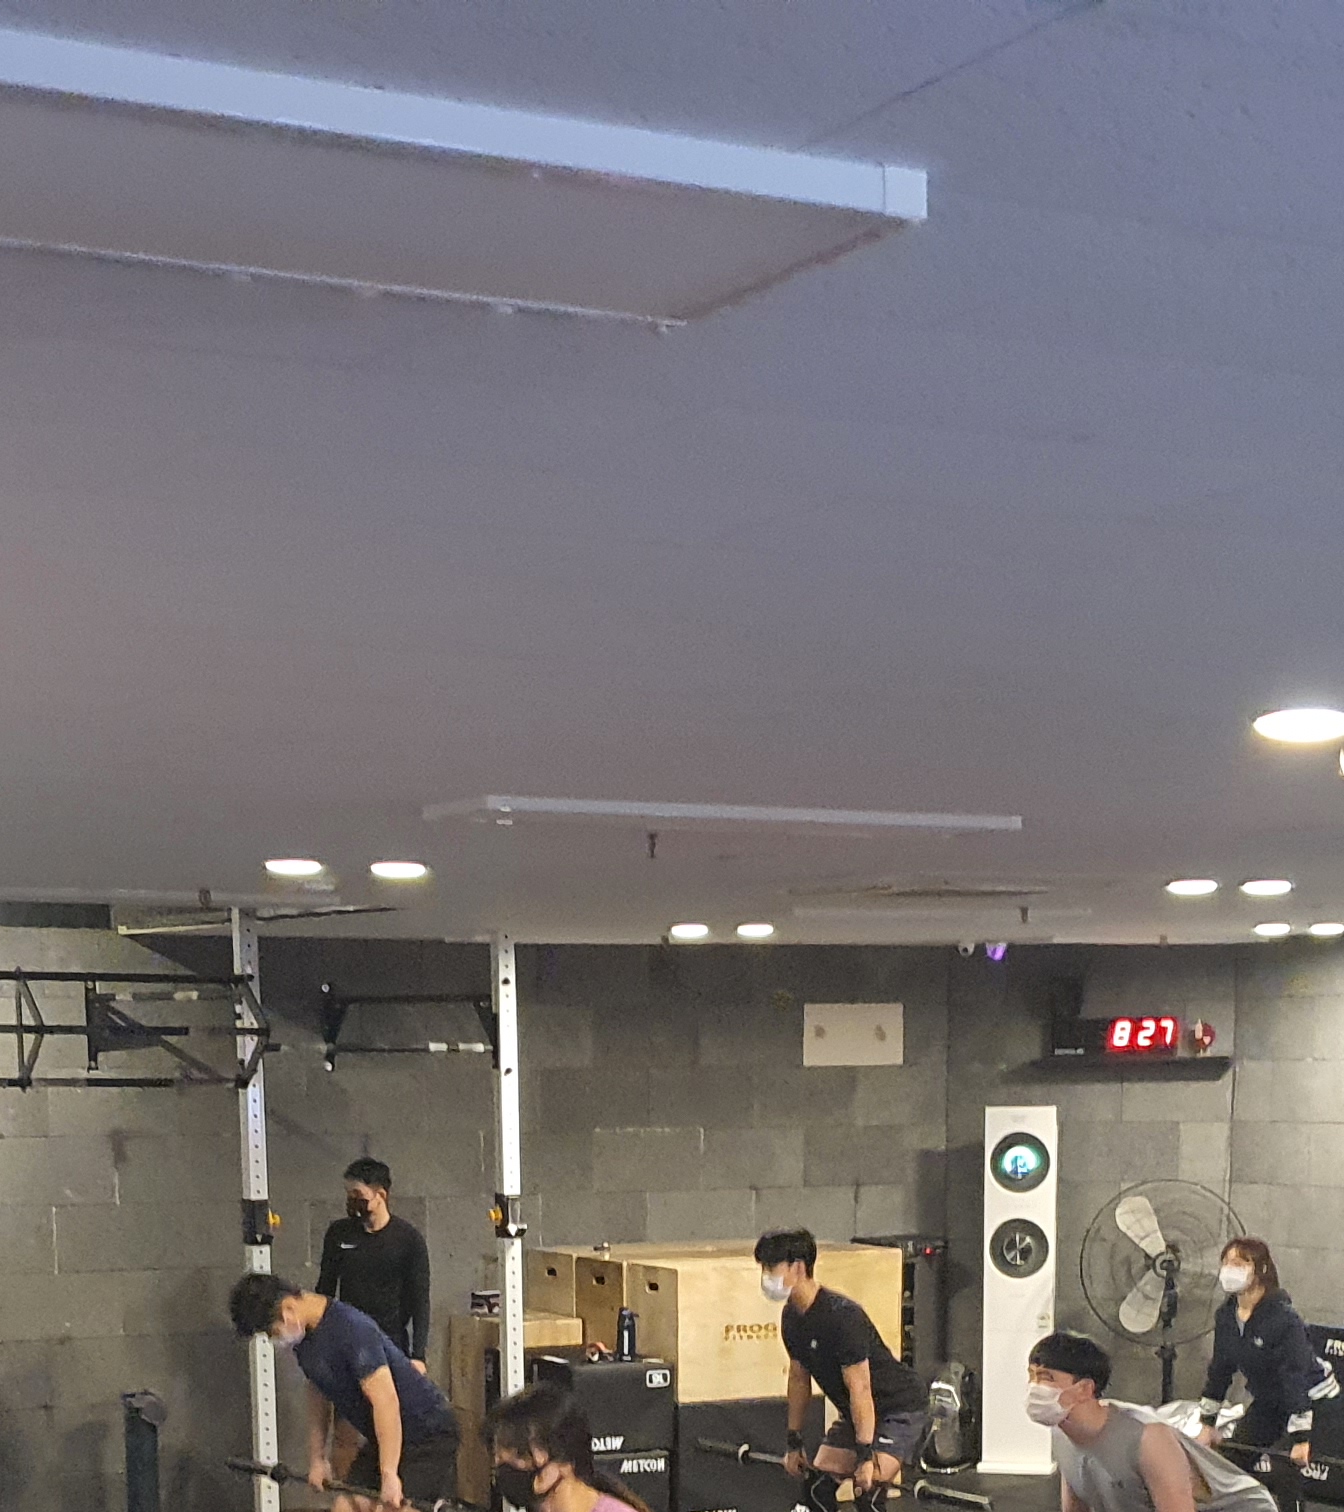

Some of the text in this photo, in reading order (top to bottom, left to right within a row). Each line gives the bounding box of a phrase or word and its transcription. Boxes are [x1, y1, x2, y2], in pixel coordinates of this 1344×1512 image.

[725, 1323, 777, 1334] FROG
[591, 1436, 624, 1451] METC
[620, 1458, 665, 1473] METCON
